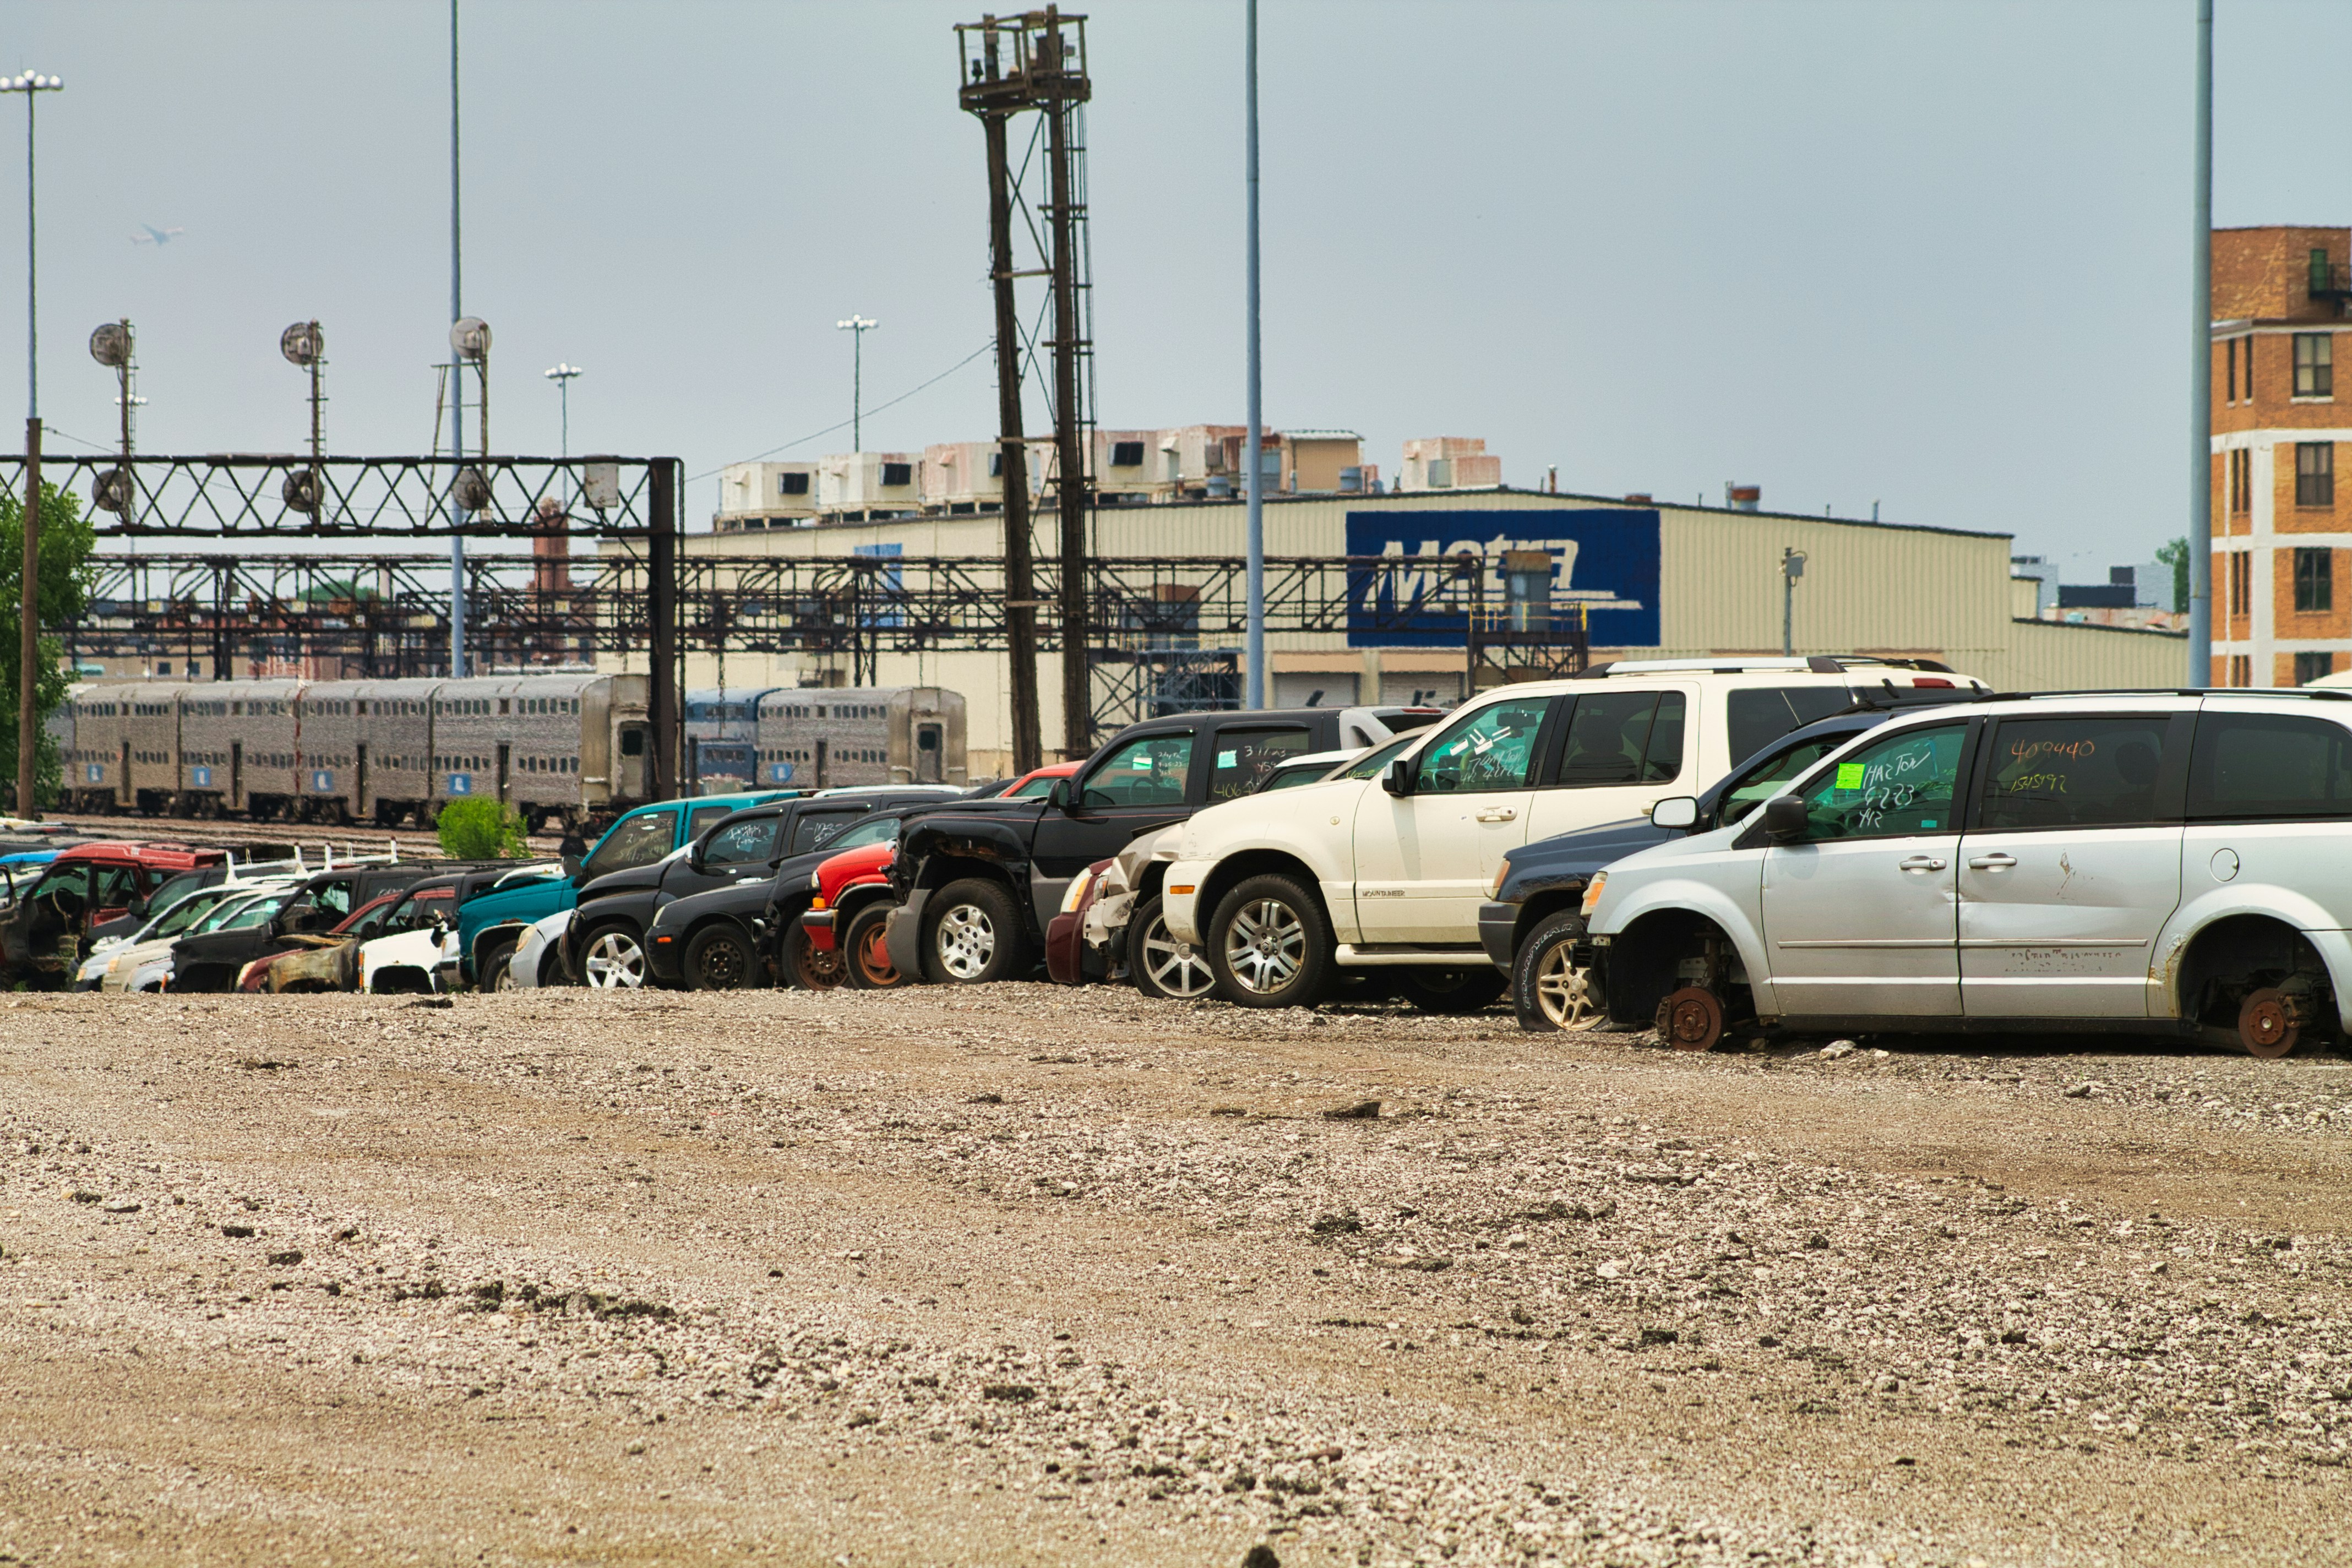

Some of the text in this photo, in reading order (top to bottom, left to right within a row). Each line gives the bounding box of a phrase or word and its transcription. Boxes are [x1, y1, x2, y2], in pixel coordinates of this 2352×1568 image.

[1363, 533, 1578, 612] Meta
[2012, 739, 2095, 764] 409440
[1521, 923, 1572, 1009] GOODYEAR
